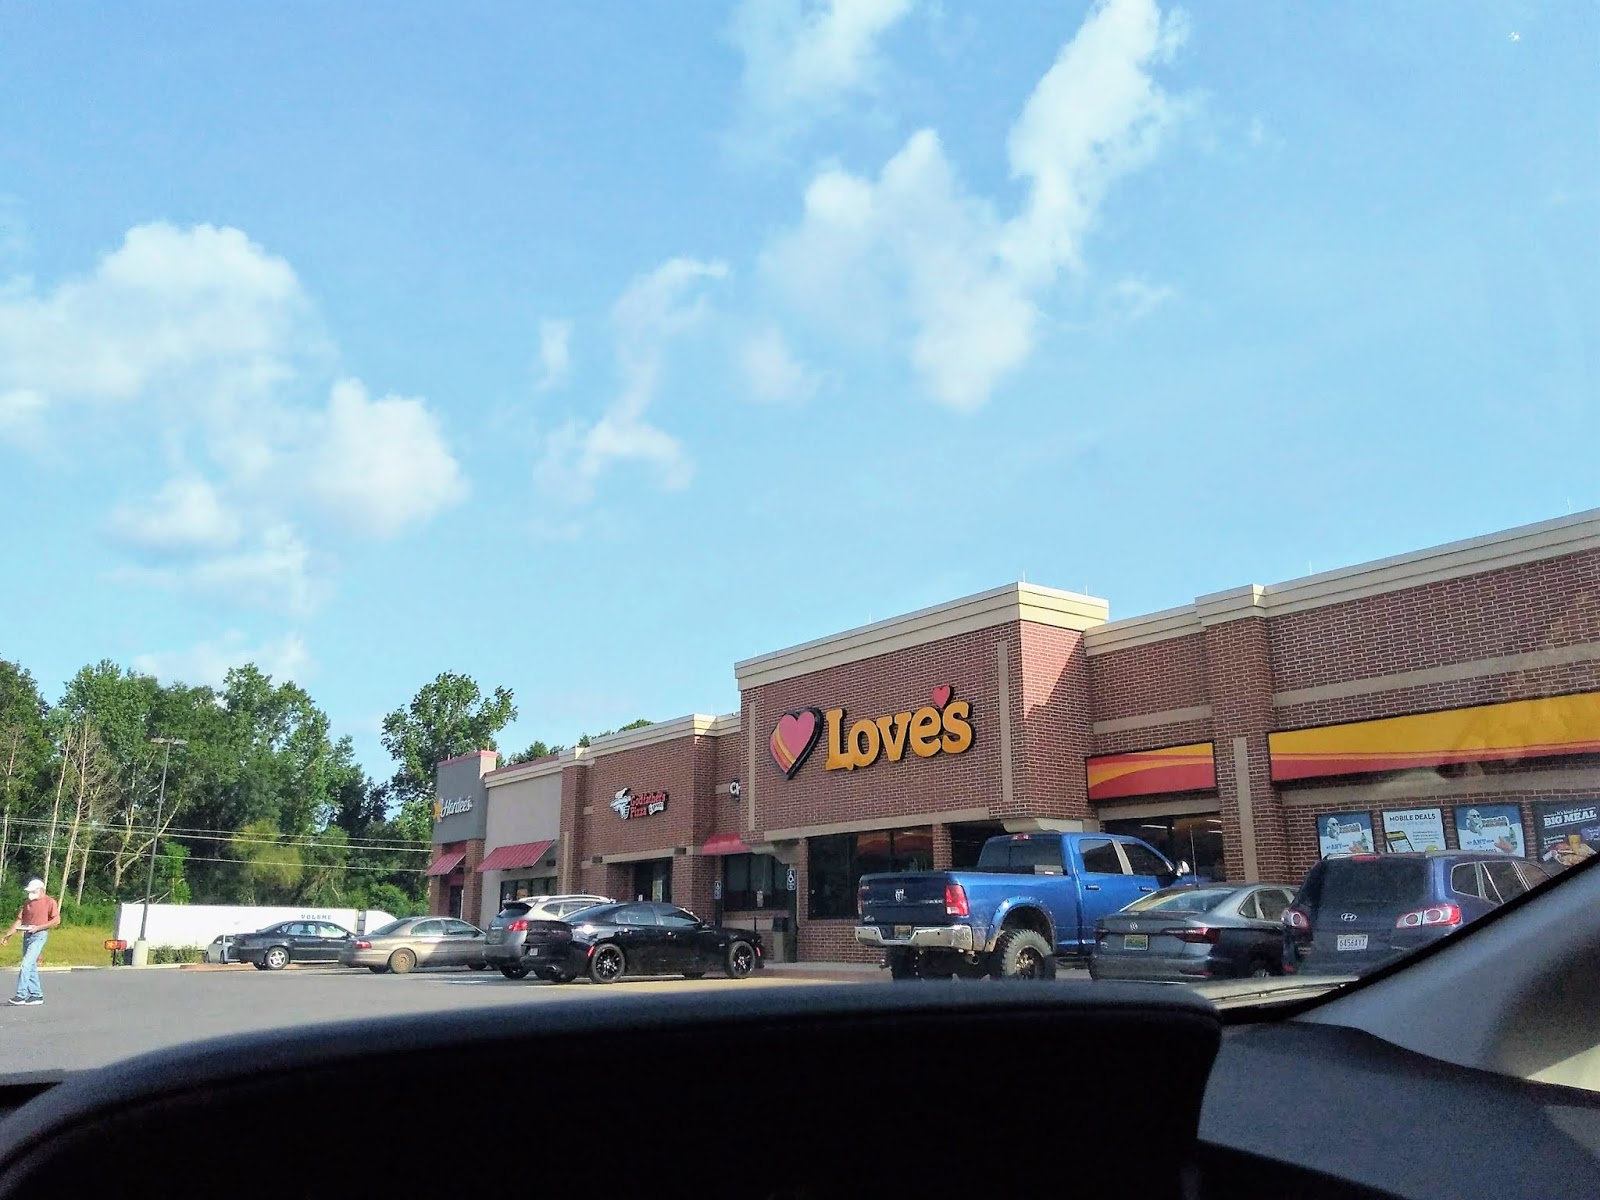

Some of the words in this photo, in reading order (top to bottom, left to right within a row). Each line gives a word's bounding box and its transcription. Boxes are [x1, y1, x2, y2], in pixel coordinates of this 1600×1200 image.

[825, 684, 973, 771] Love's
[630, 806, 647, 818] Pizza
[1389, 814, 1413, 822] MOBILE
[1543, 815, 1563, 827] BIG
[1564, 810, 1597, 823] MEAL
